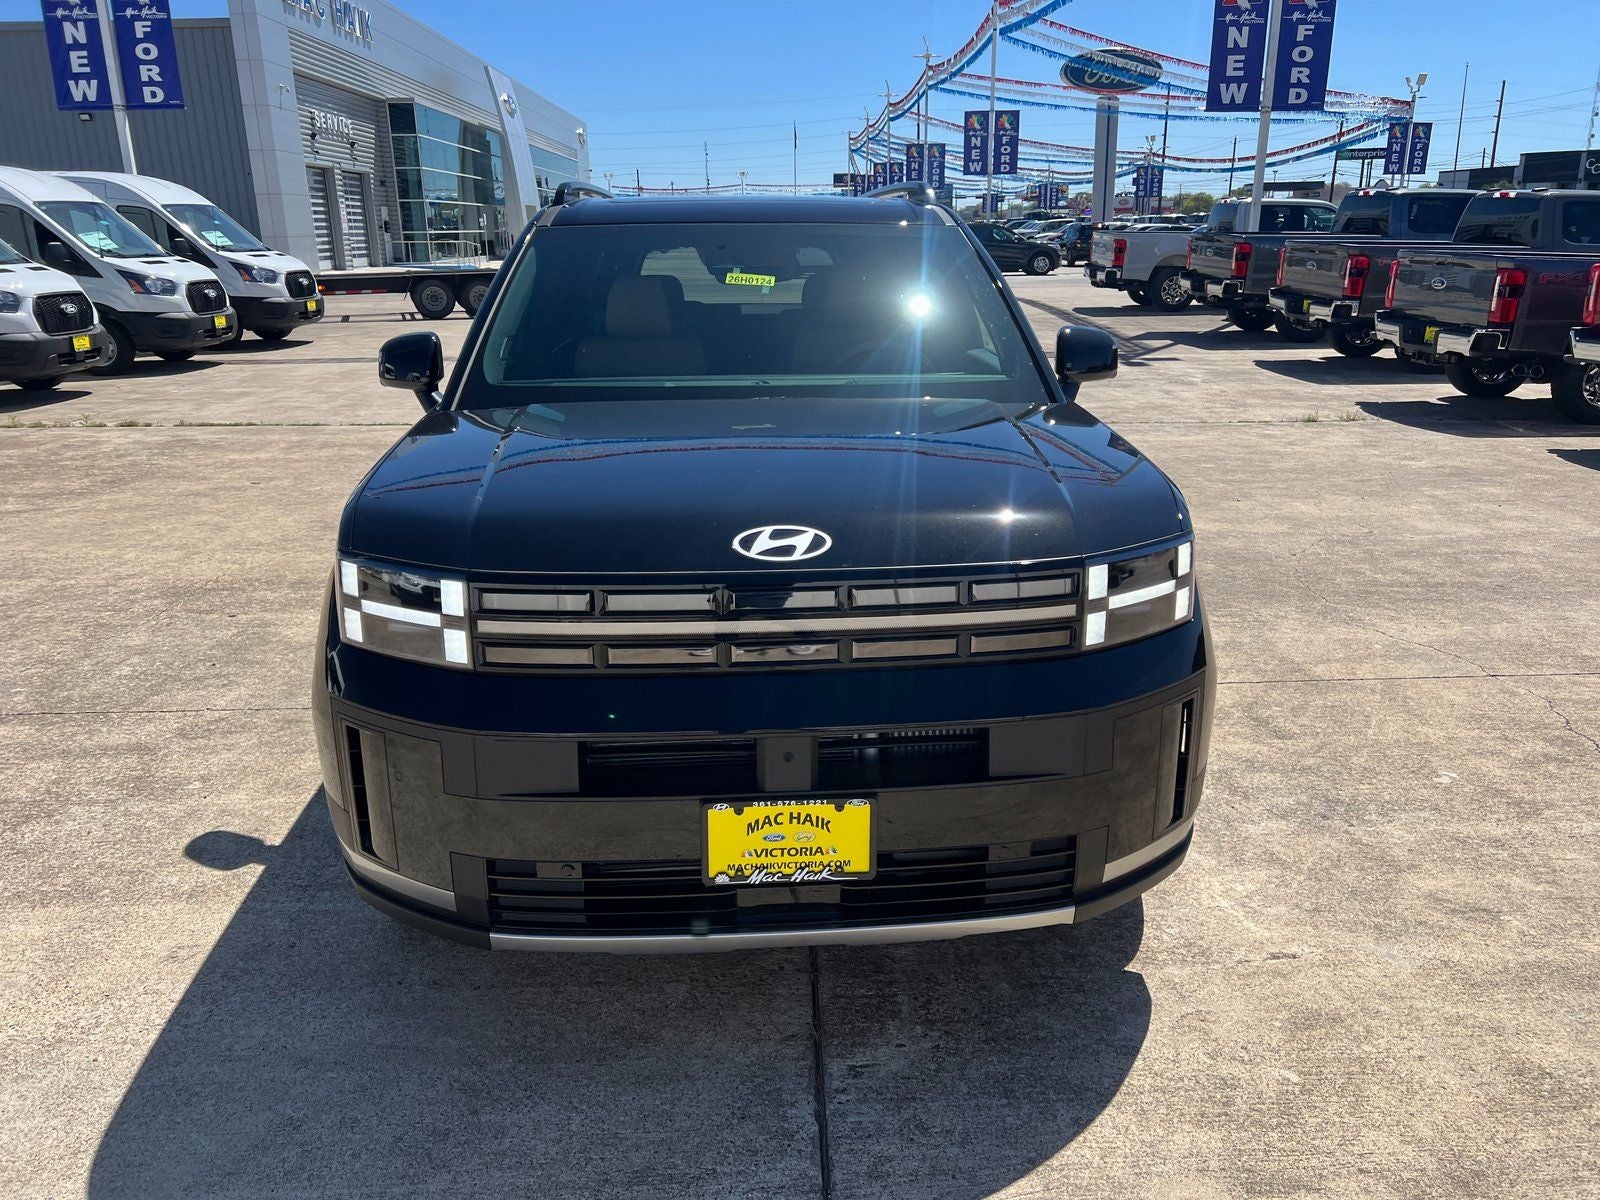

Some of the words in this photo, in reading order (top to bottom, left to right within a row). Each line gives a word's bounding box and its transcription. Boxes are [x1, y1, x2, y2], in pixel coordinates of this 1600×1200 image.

[332, 0, 374, 43] HAIK
[62, 21, 98, 102] NEW
[134, 21, 165, 103] FORD
[1219, 26, 1250, 104] NEW
[1287, 24, 1315, 104] FORD
[968, 136, 983, 172] NEW
[1000, 136, 1011, 172] FORD
[1344, 149, 1387, 158] enterpris
[1388, 143, 1401, 172] NEW
[1412, 143, 1424, 173] FORD
[911, 161, 920, 179] NE
[932, 161, 940, 188] FORD
[728, 275, 772, 285] 26H0124
[752, 799, 828, 808] 361-576-1221
[746, 812, 784, 836] MAC
[788, 811, 832, 833] HAIK
[727, 859, 852, 872] MACHAIKVICTORIA.COM
[753, 846, 825, 858] VICTORIA
[746, 868, 789, 885] Mac
[790, 866, 838, 884] Haik
